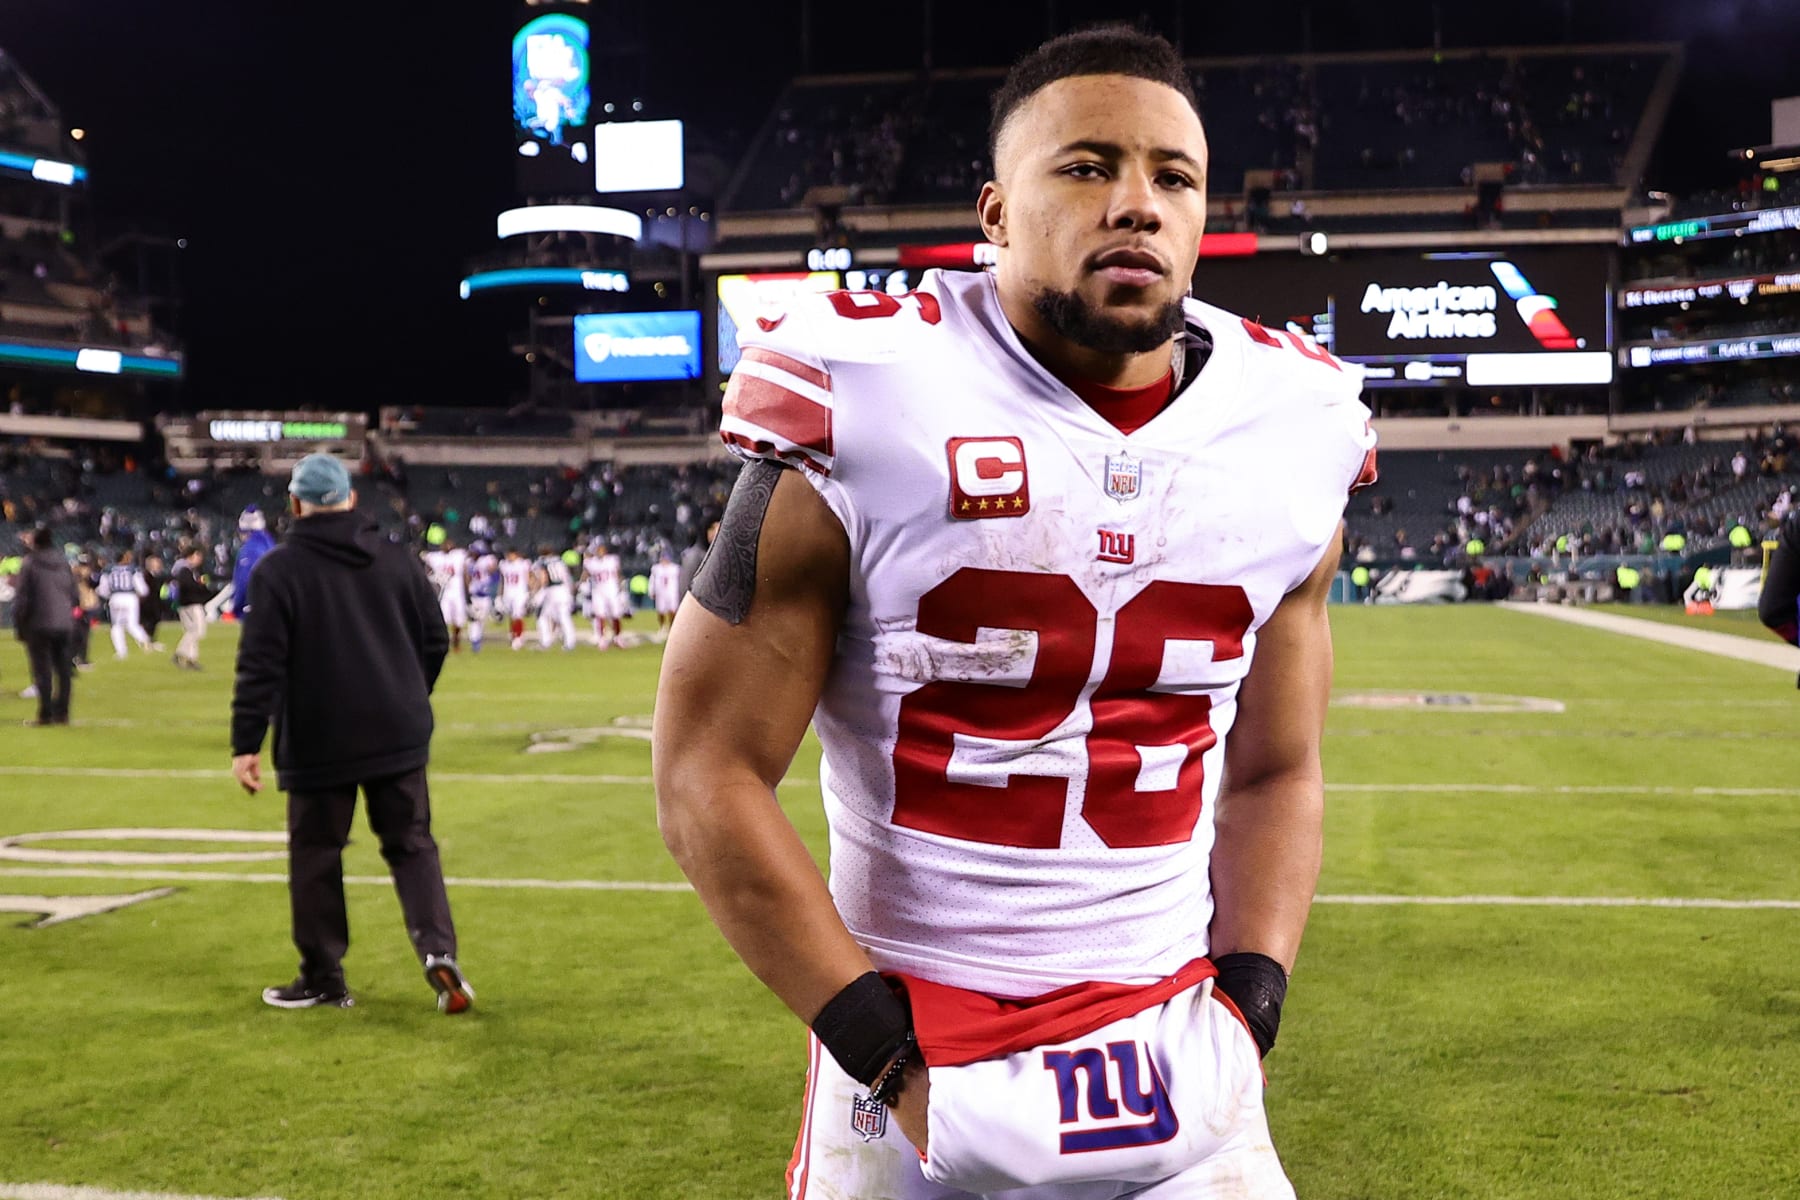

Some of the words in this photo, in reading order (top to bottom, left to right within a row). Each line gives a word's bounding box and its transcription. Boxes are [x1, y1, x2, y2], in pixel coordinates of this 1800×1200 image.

[808, 249, 851, 270] 0:00
[1361, 281, 1497, 313] American
[1387, 310, 1497, 339] Airlines
[955, 440, 1024, 497] C
[1111, 474, 1137, 494] NFL
[891, 566, 1255, 850] 26
[854, 1111, 879, 1134] NFL
